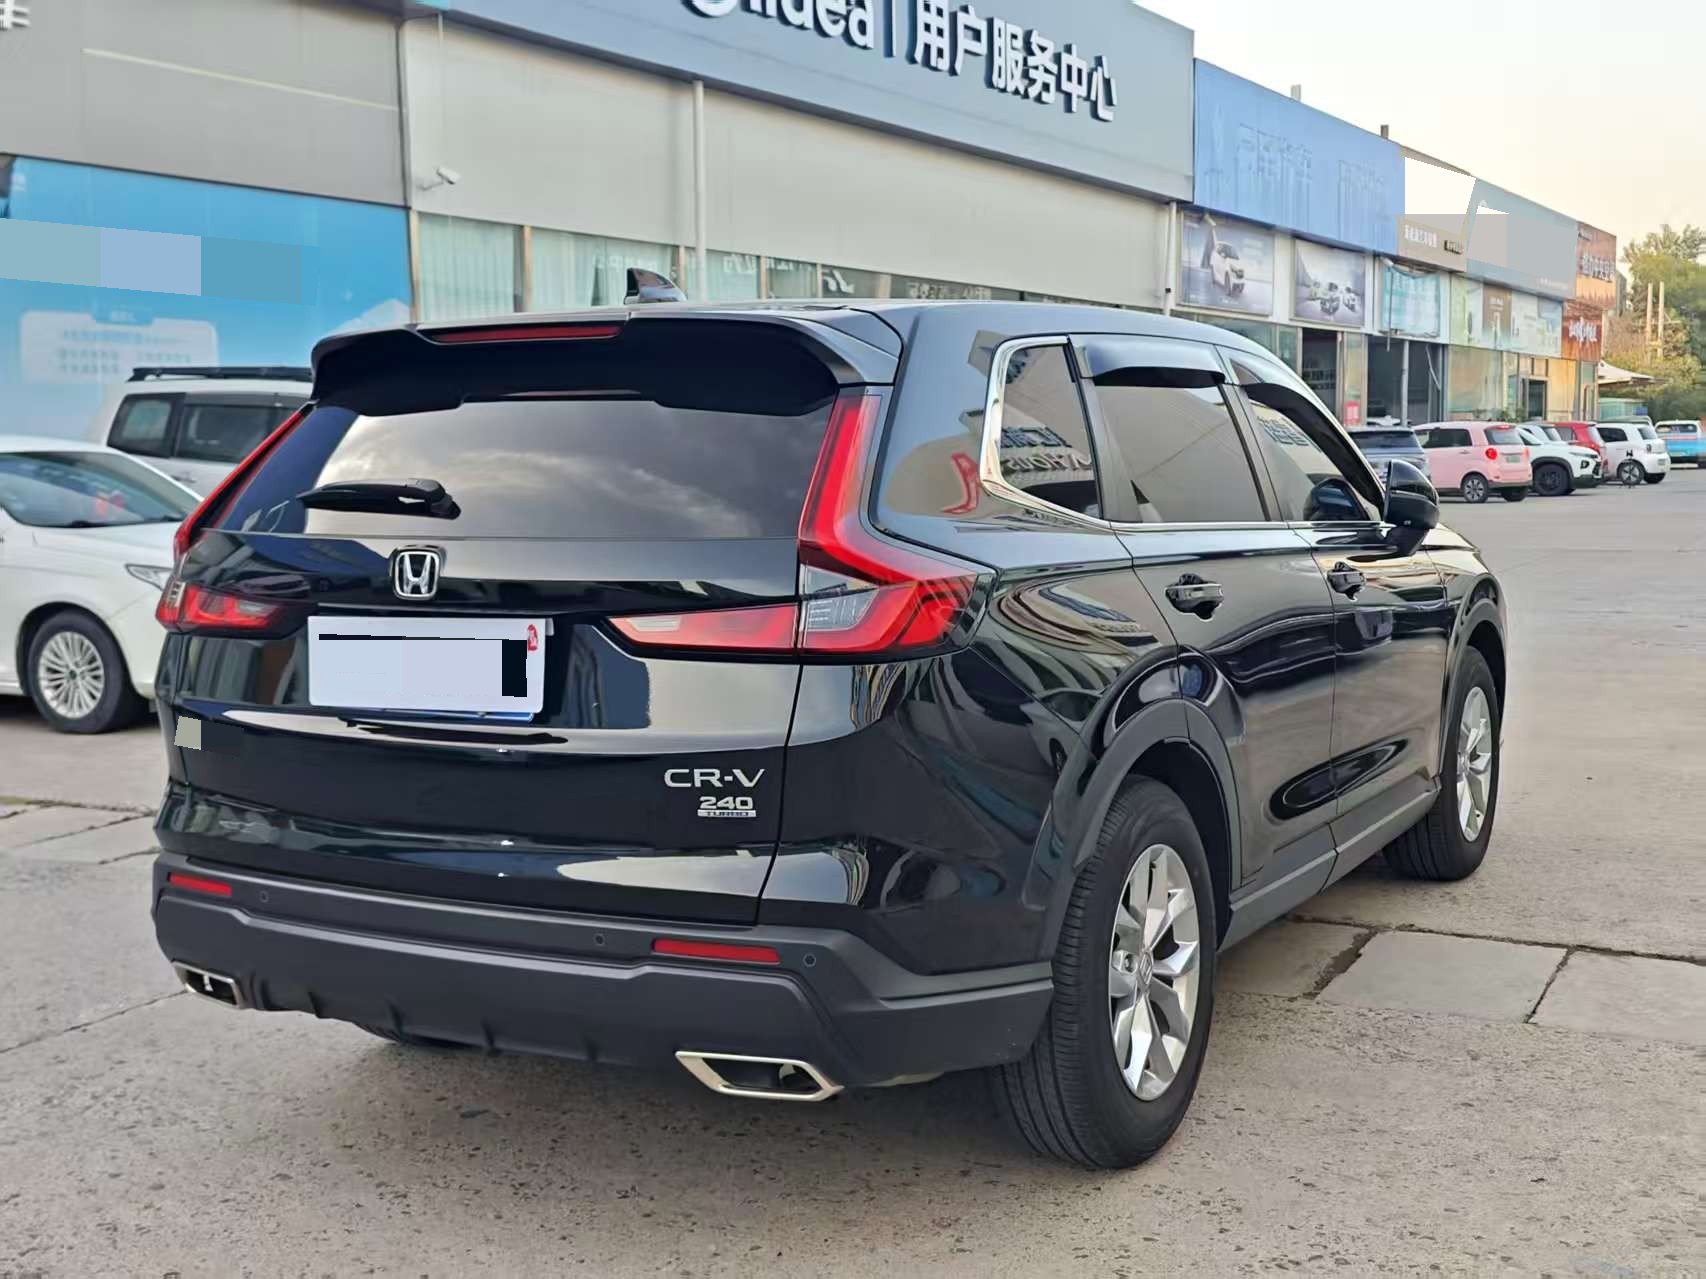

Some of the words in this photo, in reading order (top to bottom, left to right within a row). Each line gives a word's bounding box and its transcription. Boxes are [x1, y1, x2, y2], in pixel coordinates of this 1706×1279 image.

[913, 0, 1118, 121] 用户服务中心
[663, 768, 765, 788] CR-V
[699, 796, 754, 810] 240
